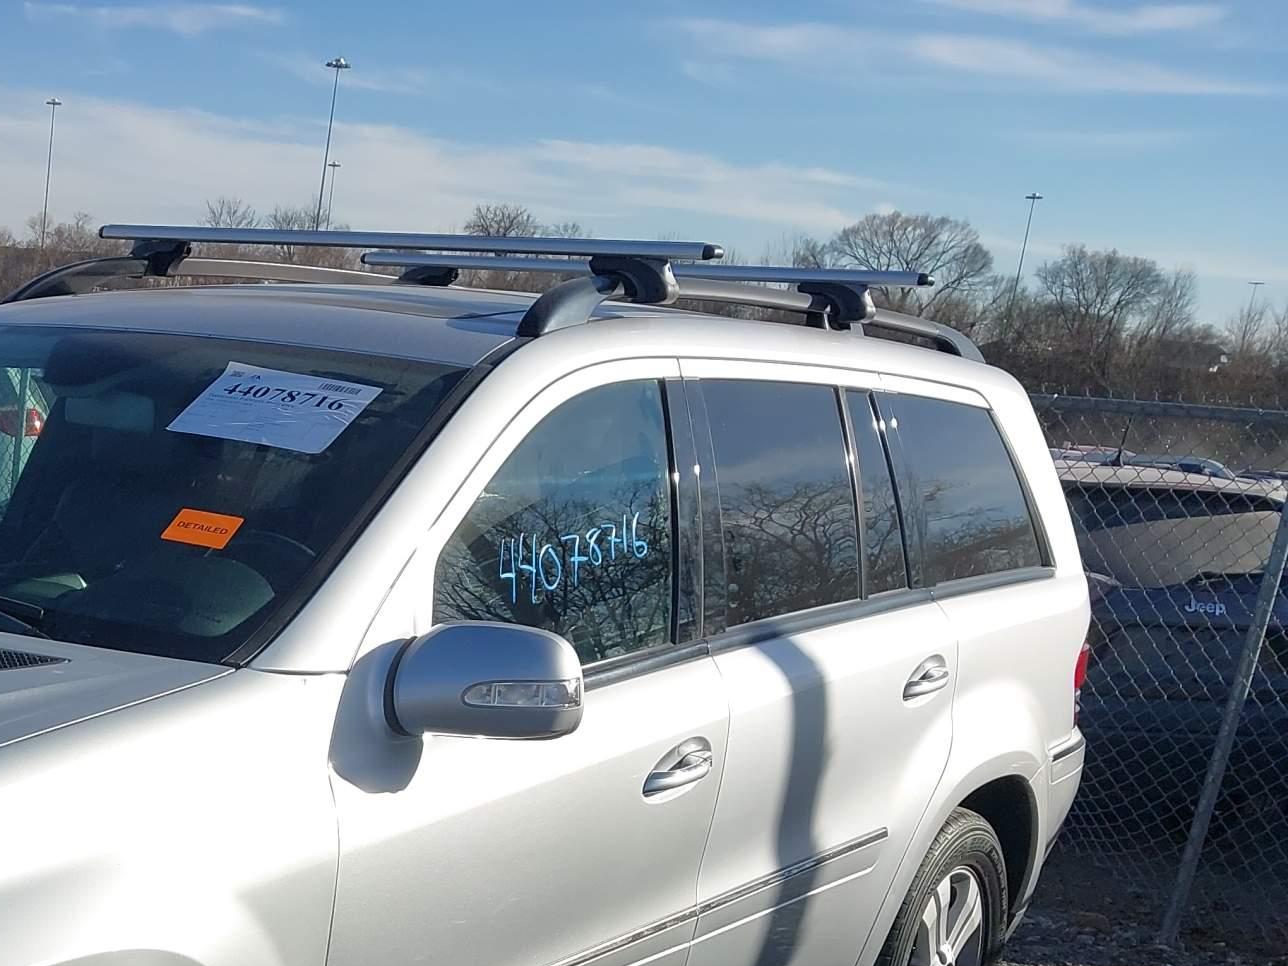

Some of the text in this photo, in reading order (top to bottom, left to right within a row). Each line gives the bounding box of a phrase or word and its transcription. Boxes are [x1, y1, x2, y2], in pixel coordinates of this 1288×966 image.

[223, 382, 348, 411] 44078716
[177, 520, 229, 535] DETAILED
[500, 511, 648, 604] 44078716
[1184, 598, 1226, 616] Jeep
